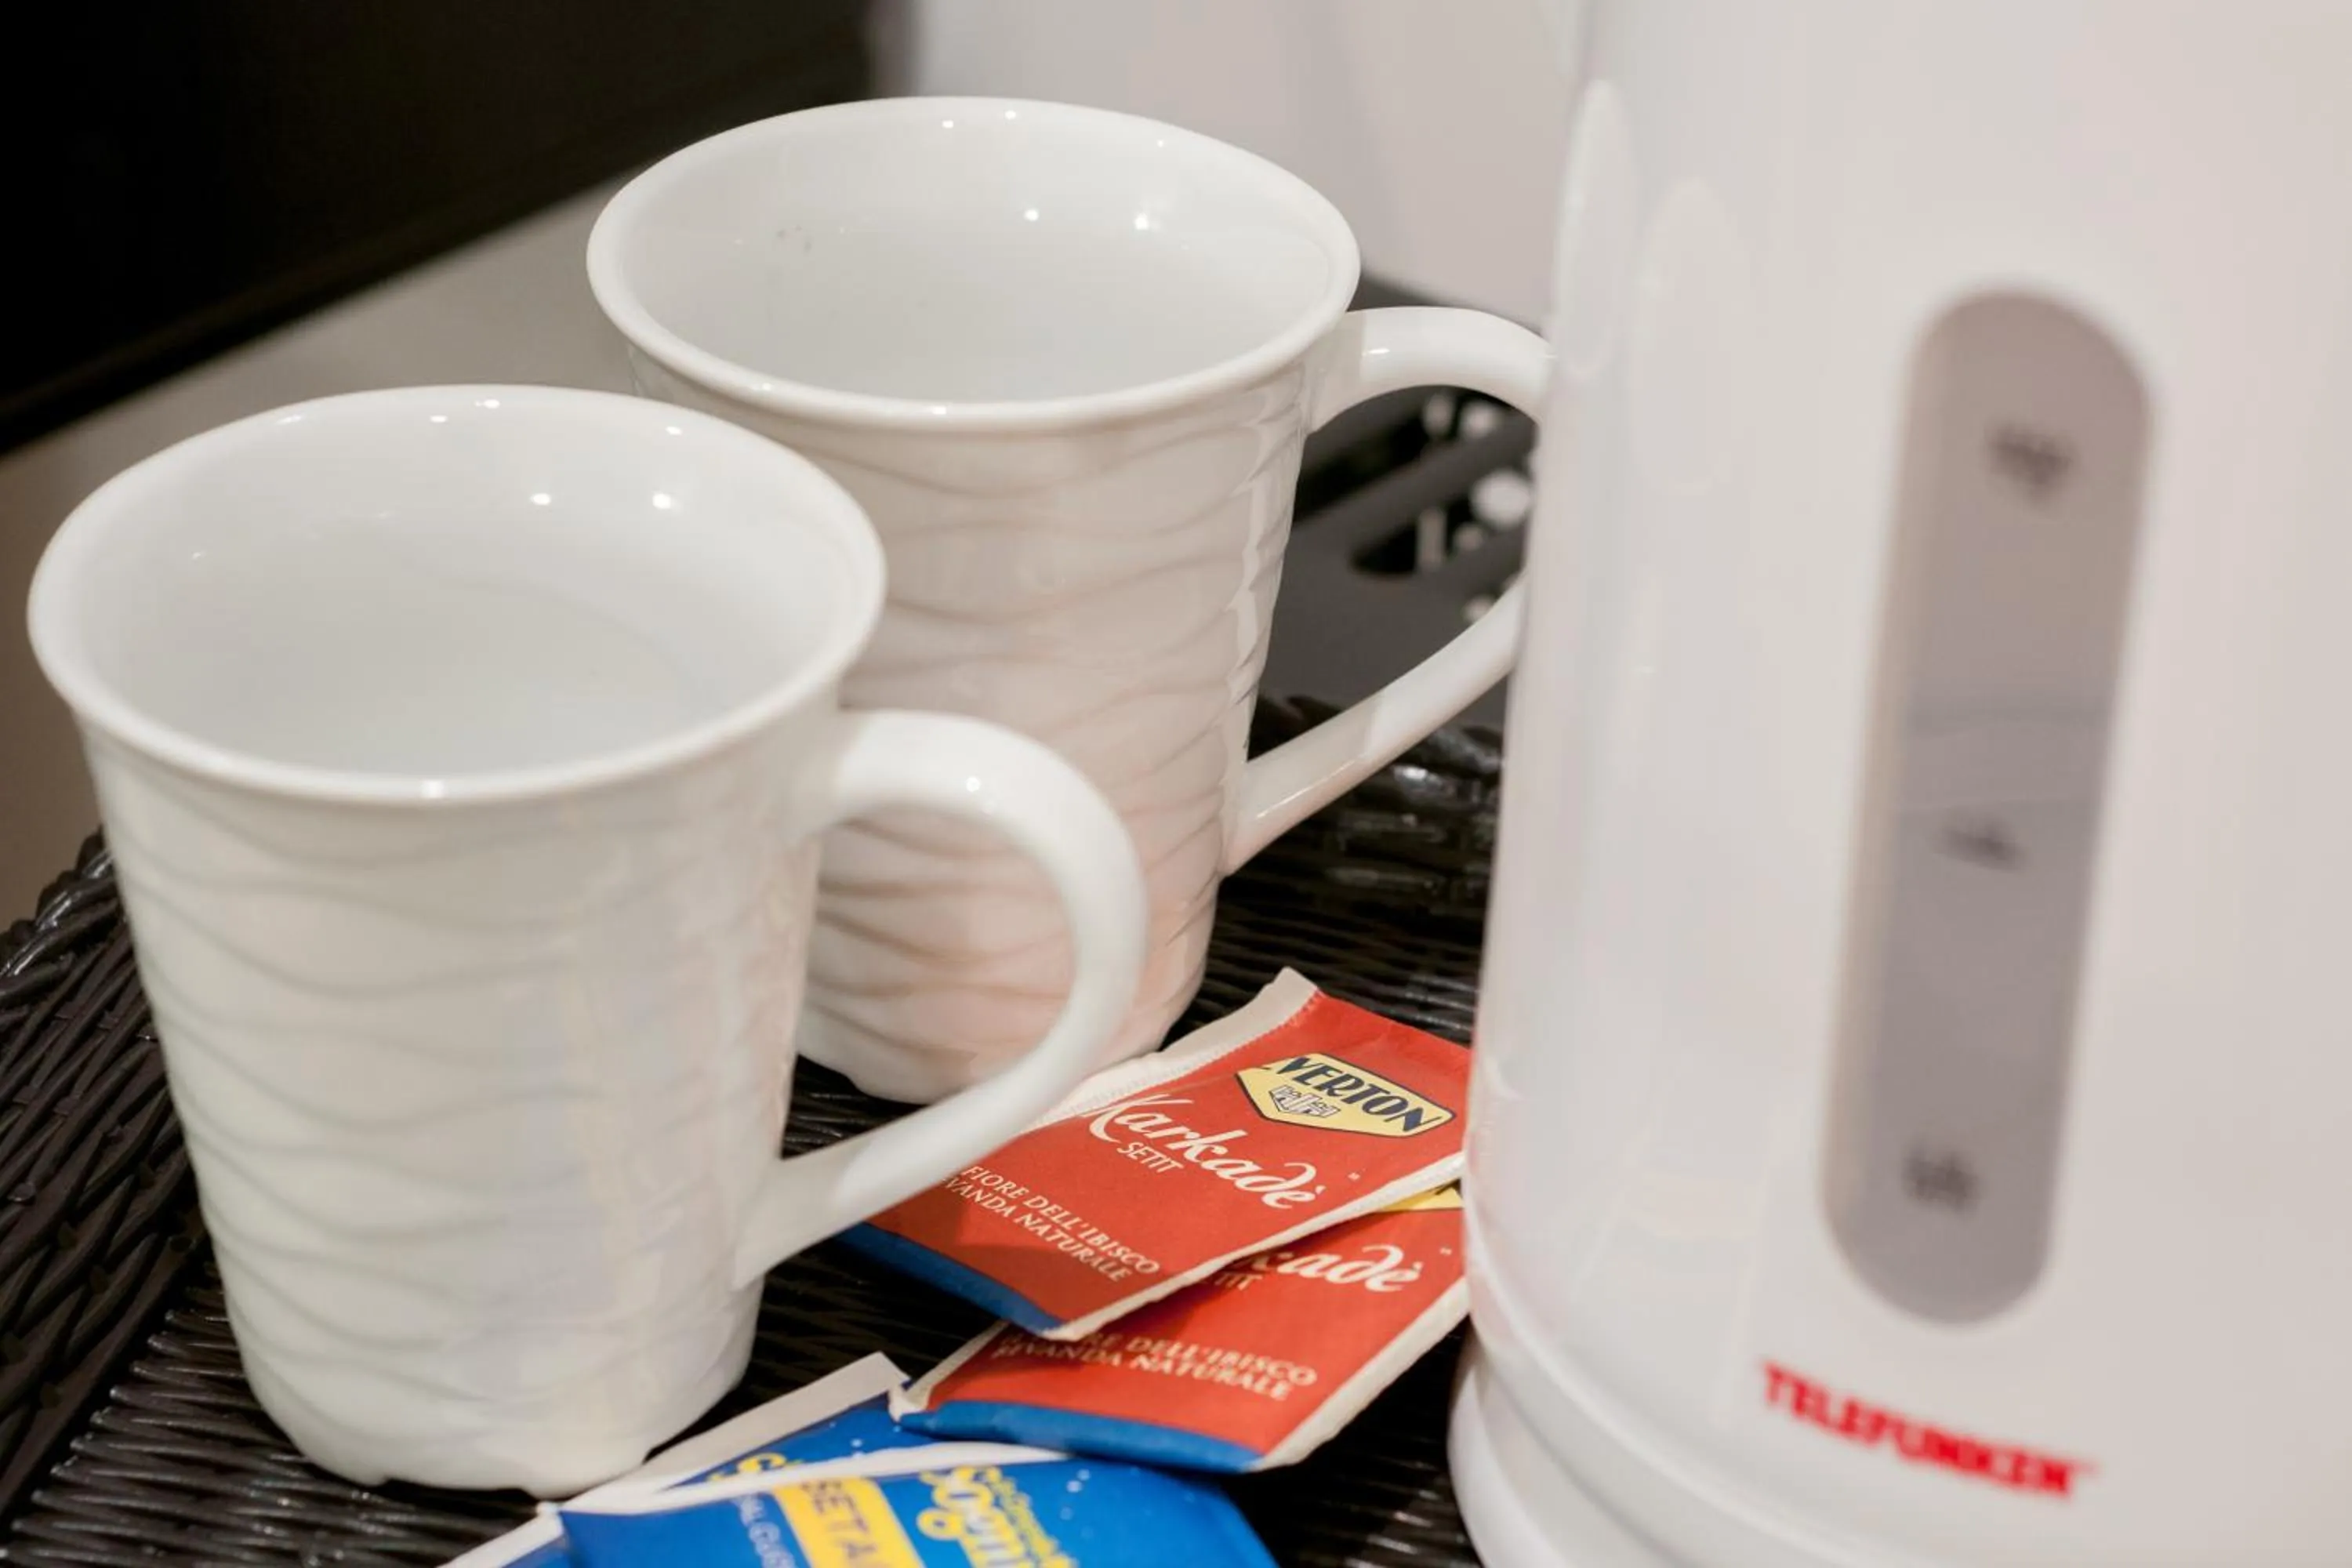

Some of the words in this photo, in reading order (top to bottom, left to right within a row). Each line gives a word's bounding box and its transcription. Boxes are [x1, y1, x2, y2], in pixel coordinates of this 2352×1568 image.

[1262, 1056, 1443, 1132] VERTON
[1082, 1093, 1327, 1209] Karkadè
[1116, 1141, 1185, 1174] SETIT
[942, 1176, 1018, 1218] VANDA
[1013, 1212, 1133, 1283] NATURALE
[960, 1165, 1029, 1200] FIORE
[1022, 1194, 1160, 1275] DELL'IBISCO
[1127, 1353, 1294, 1402] NATURALE
